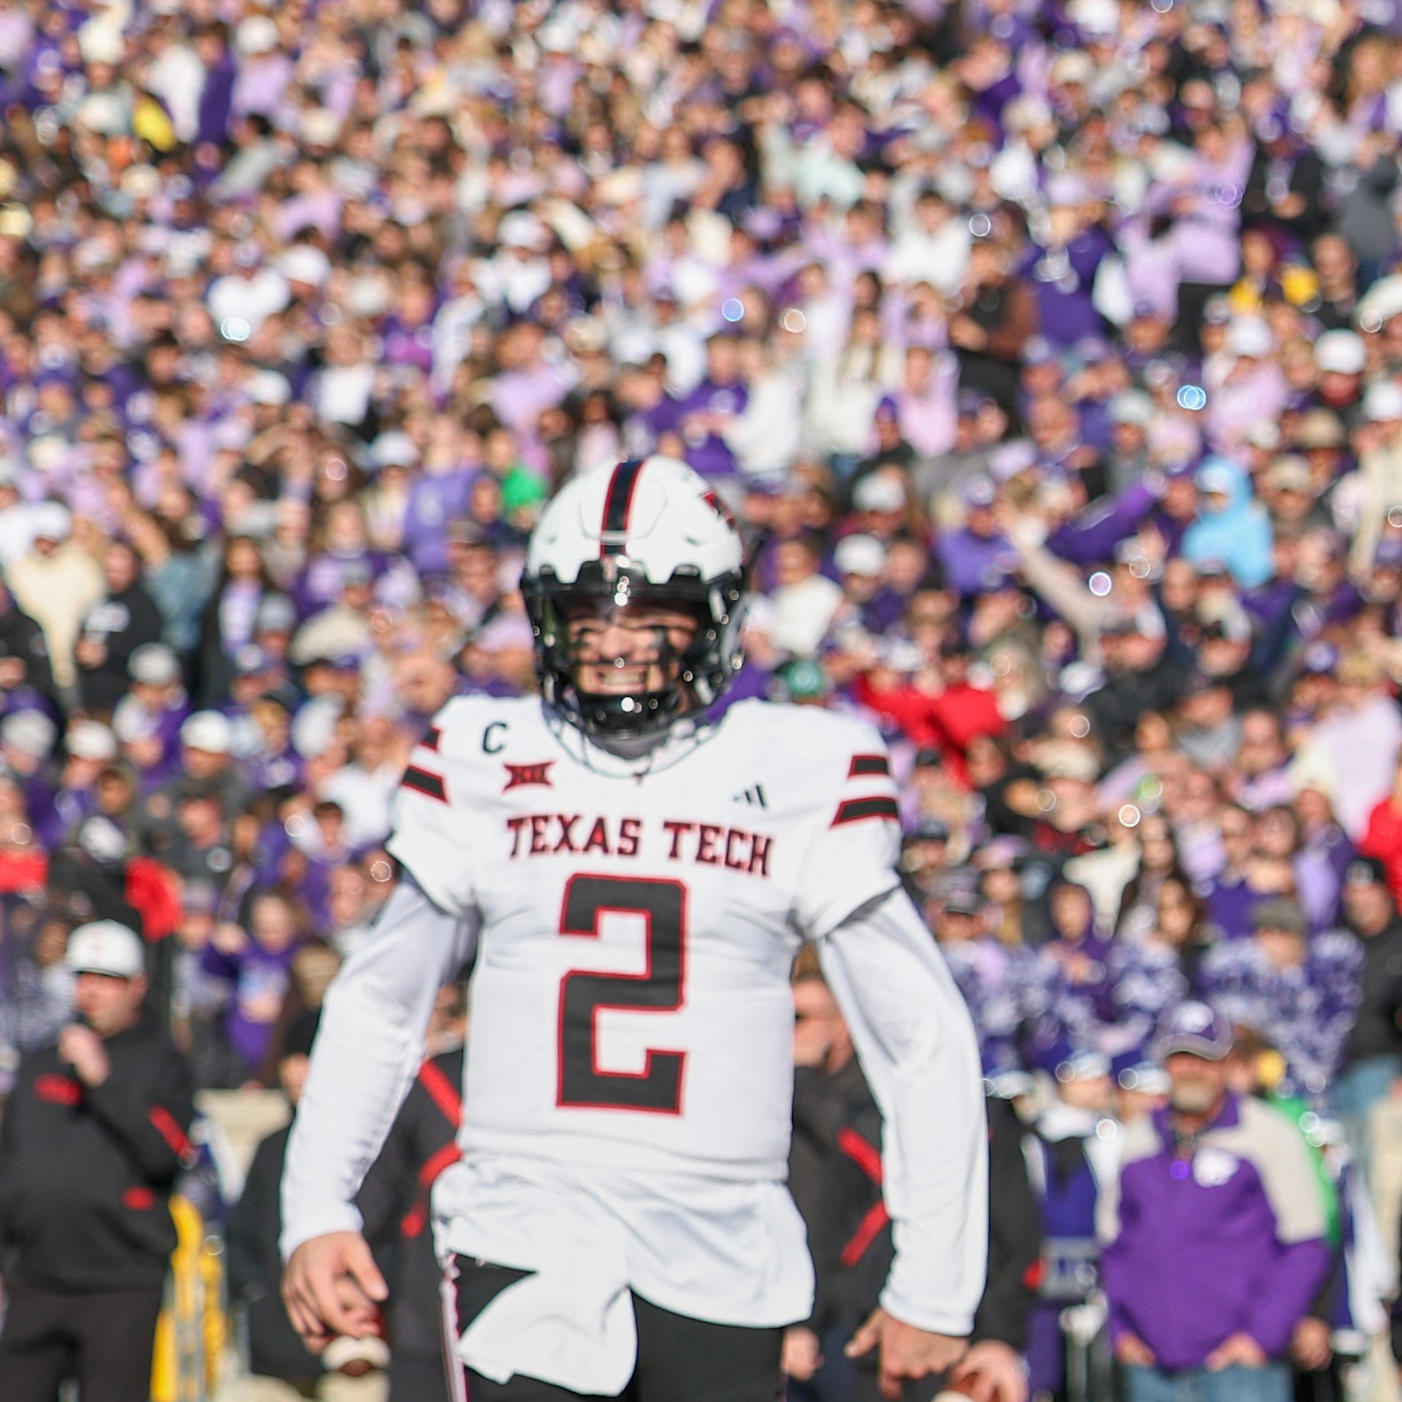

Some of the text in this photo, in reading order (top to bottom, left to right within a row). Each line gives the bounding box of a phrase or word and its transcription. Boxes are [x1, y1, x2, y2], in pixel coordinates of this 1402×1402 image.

[482, 722, 508, 754] C
[507, 814, 775, 876] TEXAS TECH
[557, 873, 688, 1116] 2
